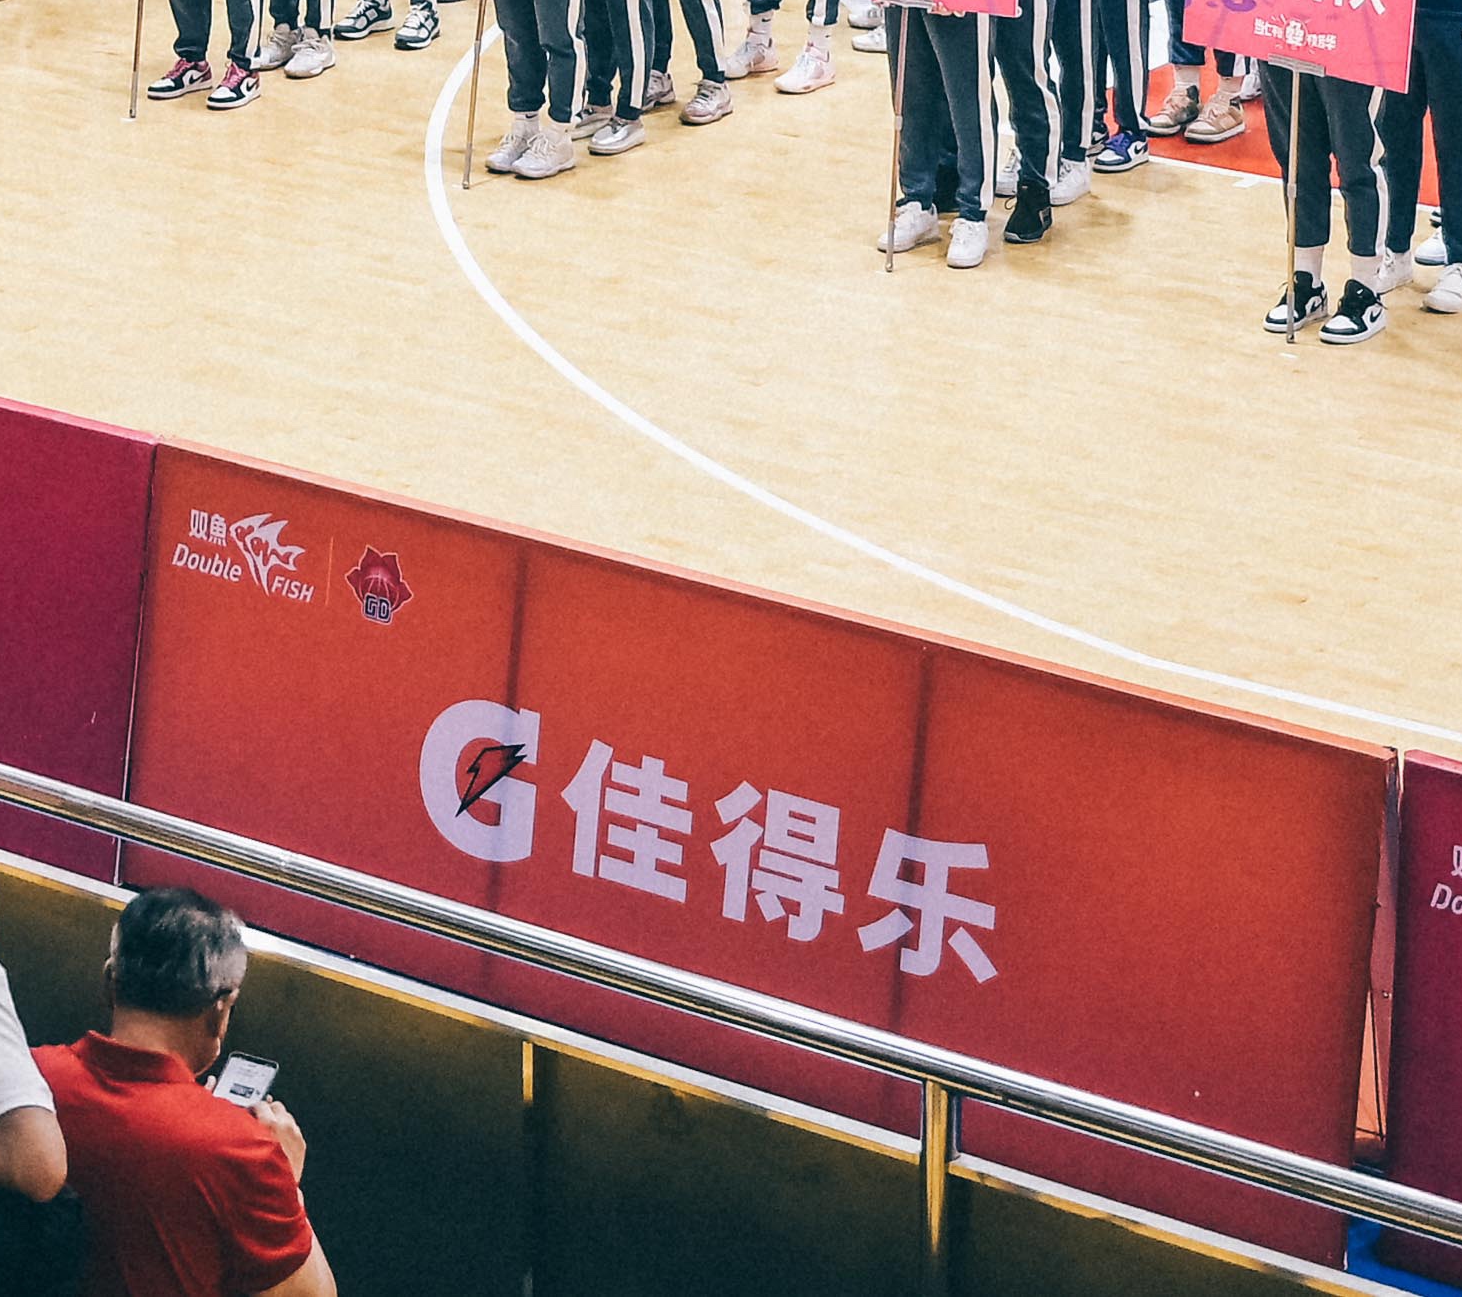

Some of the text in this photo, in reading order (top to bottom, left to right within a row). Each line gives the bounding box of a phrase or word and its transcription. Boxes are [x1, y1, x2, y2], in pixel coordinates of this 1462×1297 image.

[171, 542, 243, 587] Double
[271, 575, 316, 606] FISH
[560, 737, 999, 986] 佳得乐
